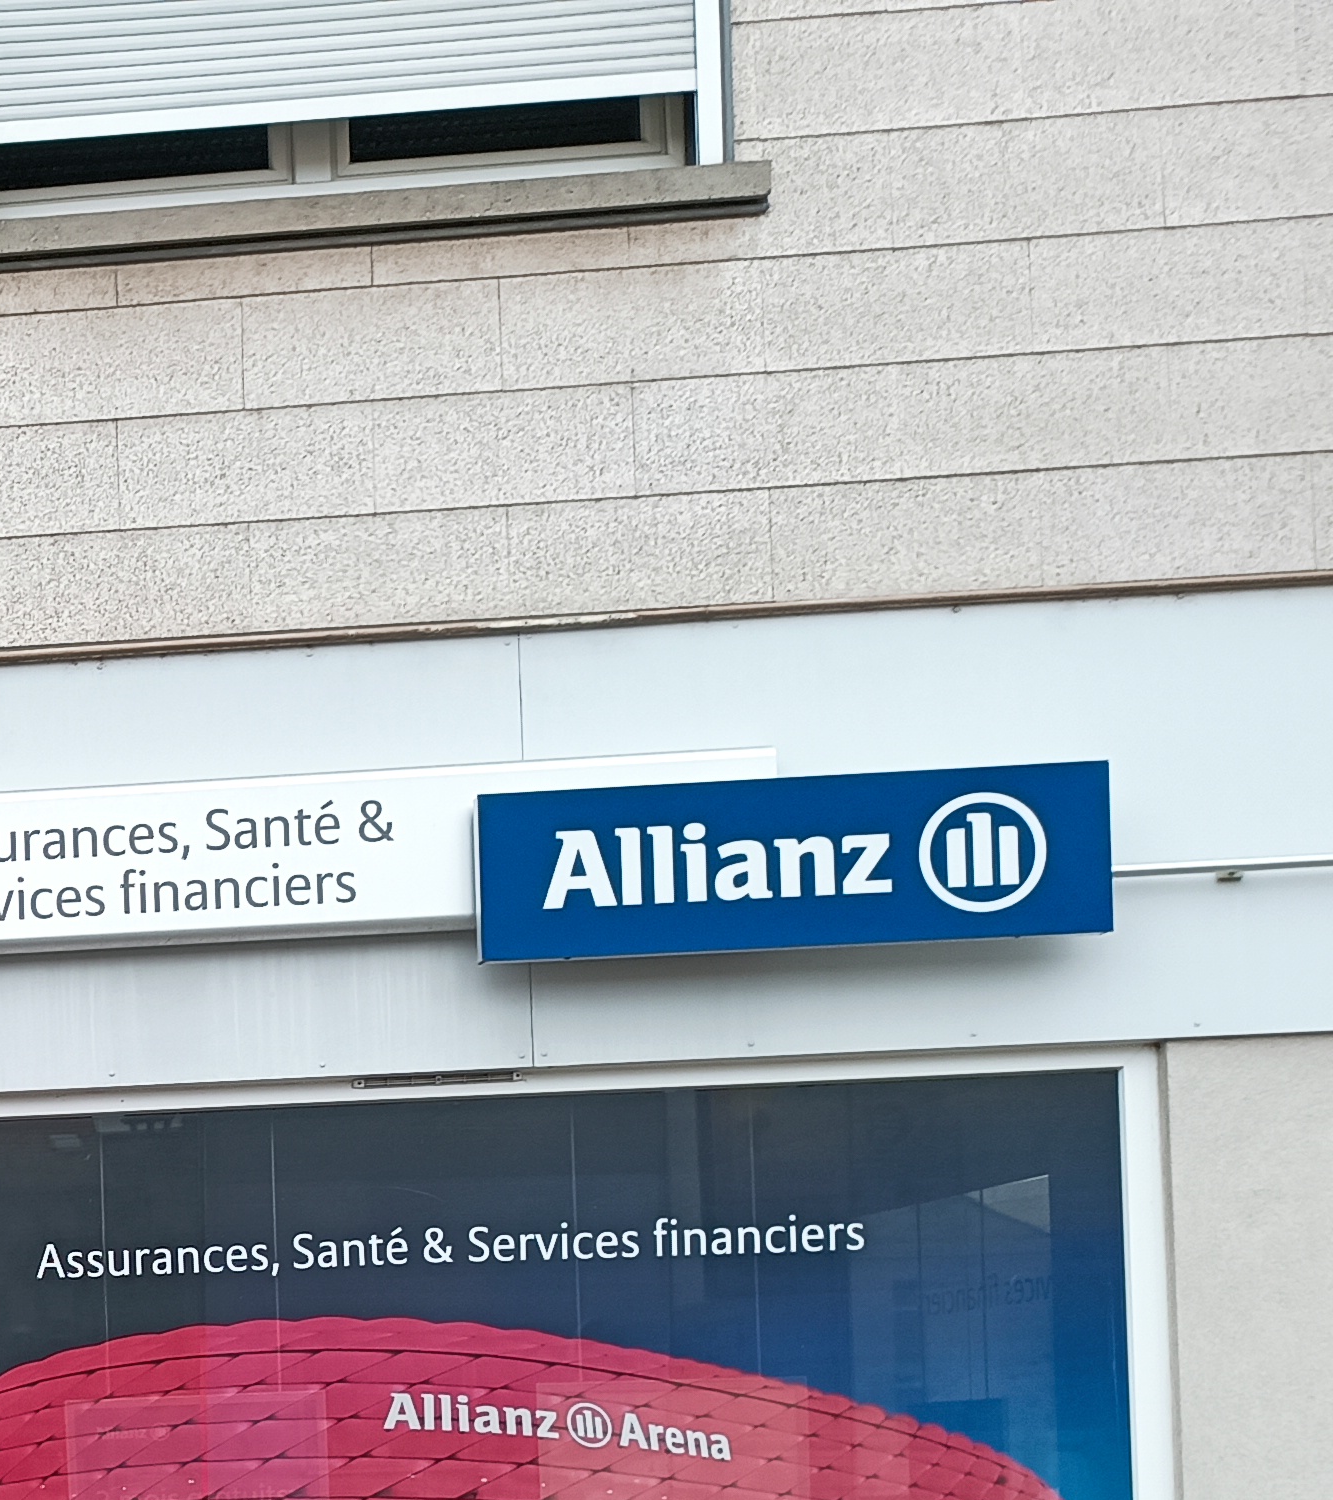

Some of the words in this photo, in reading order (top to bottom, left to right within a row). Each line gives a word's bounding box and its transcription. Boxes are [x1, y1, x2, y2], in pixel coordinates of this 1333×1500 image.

[204, 798, 342, 851] Santé
[357, 799, 395, 843] &
[118, 868, 358, 916] financiers
[542, 822, 893, 910] Allianz
[36, 1242, 281, 1280] Assurances,
[293, 1226, 410, 1270] Santé
[423, 1227, 455, 1264] &
[468, 1221, 641, 1263] Services
[652, 1214, 866, 1257] financiers
[383, 1392, 561, 1440] Allianz
[619, 1412, 733, 1461] Arena
